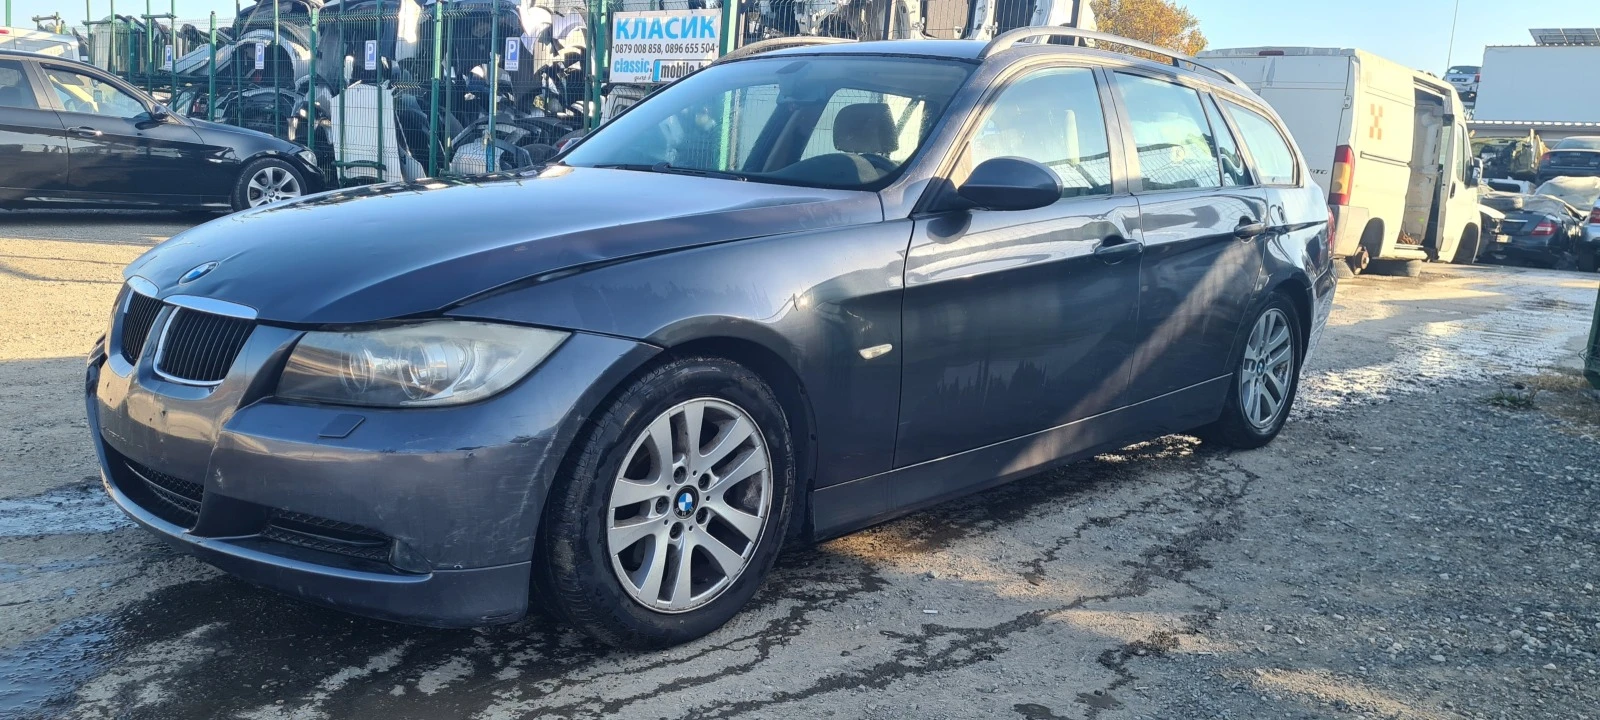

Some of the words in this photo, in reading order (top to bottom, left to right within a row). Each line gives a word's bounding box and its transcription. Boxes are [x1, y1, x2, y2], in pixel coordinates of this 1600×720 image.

[616, 16, 715, 39] КЛАСИК
[508, 41, 516, 60] P
[615, 44, 632, 53] 0879
[633, 44, 647, 53] 008
[665, 44, 683, 53] 0896
[685, 43, 698, 53] 655
[700, 43, 715, 53] 504
